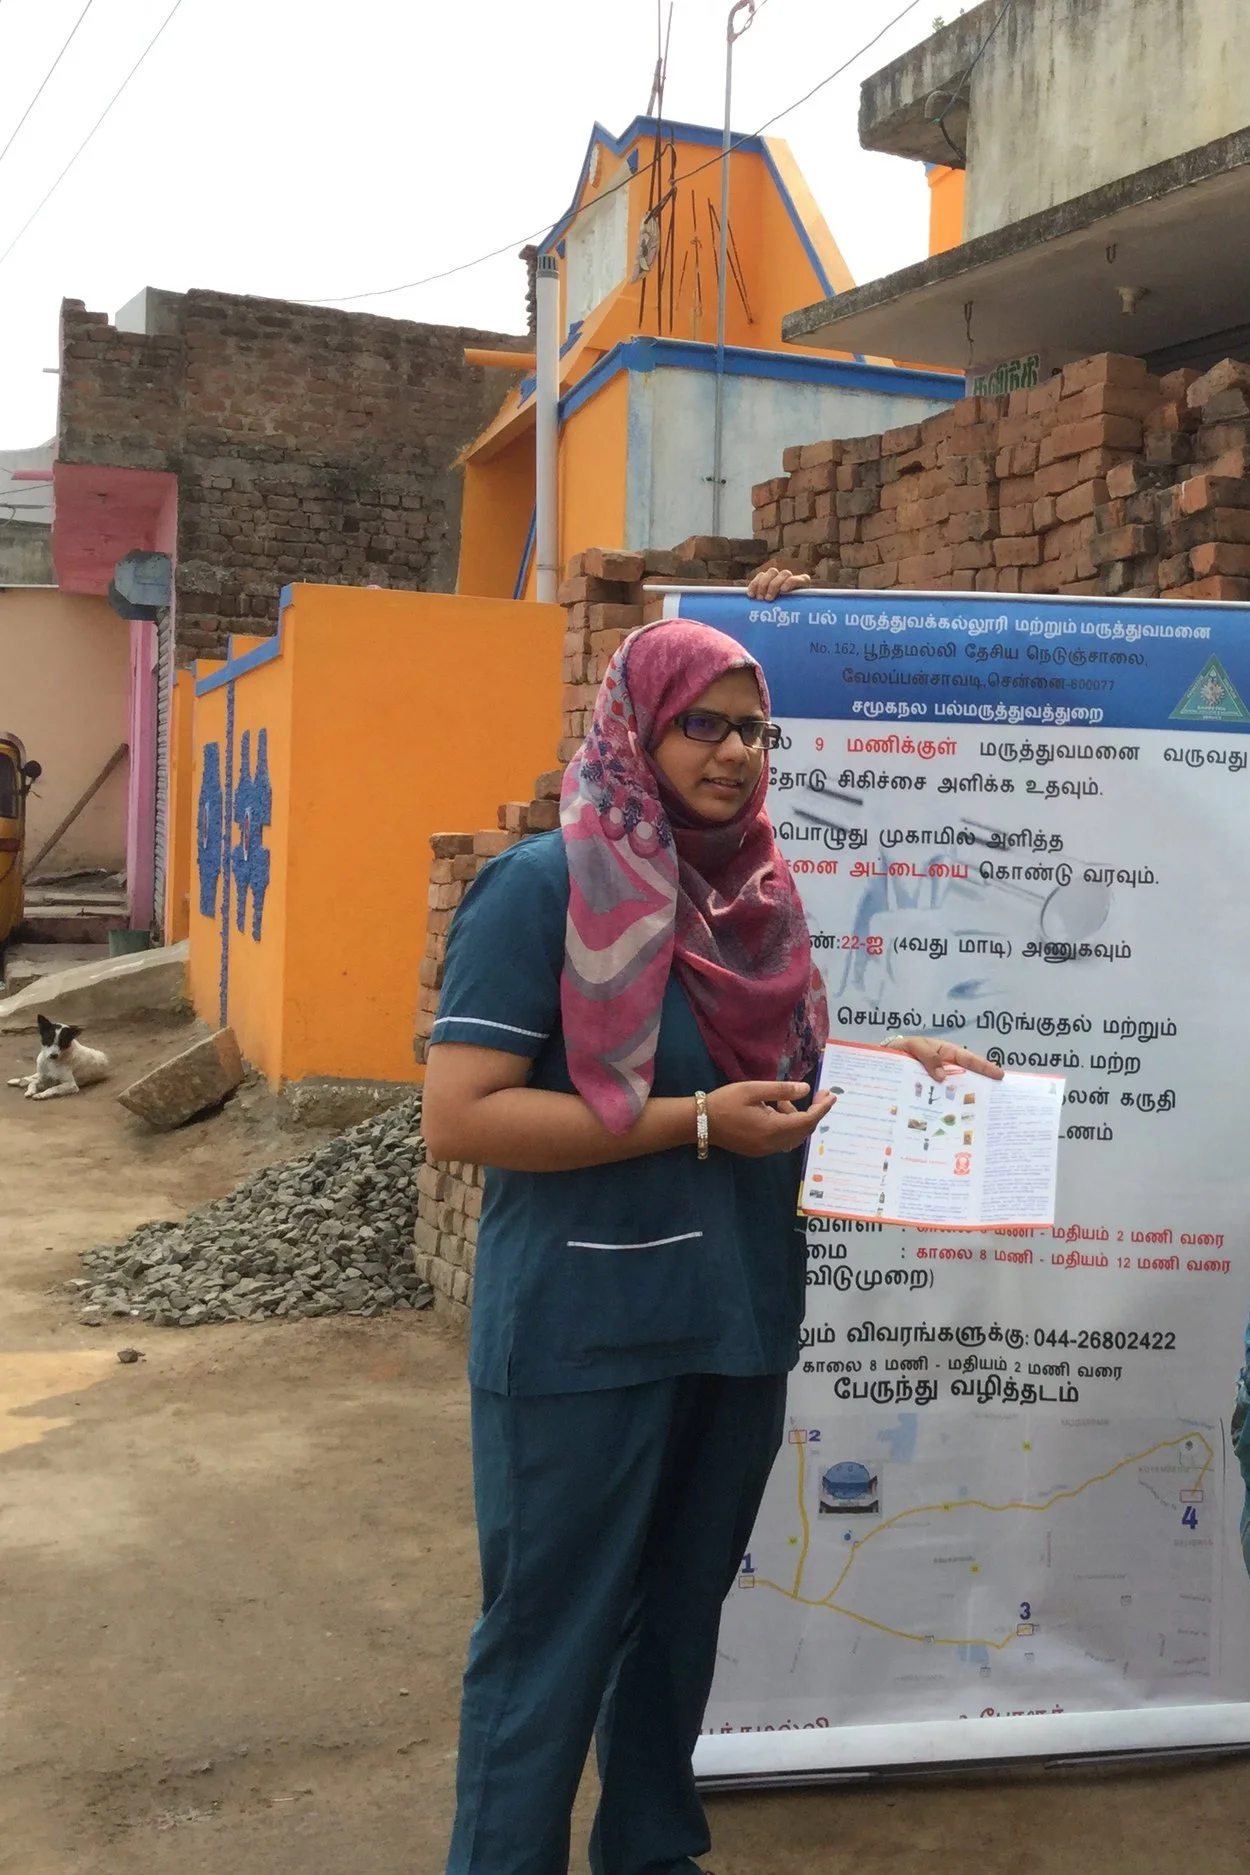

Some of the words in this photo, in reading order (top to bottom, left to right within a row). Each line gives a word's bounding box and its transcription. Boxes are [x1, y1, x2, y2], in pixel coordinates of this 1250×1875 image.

[749, 607, 801, 627] சவீதா
[808, 611, 837, 626] பல்
[845, 611, 1008, 635] மருத்துவக்கல்லூரி
[1015, 616, 1077, 638] மற்றும்
[1081, 620, 1212, 642] மருத்துவமனை
[810, 642, 830, 655] No.
[835, 643, 860, 656] 162,
[864, 640, 956, 662] பூந்தமல்லி
[964, 643, 1018, 662] தேசிய
[852, 699, 927, 719] சமூகநல
[935, 701, 1104, 725] பல்மருத்துவத்துறை
[815, 737, 825, 751] 9
[847, 734, 957, 760] மணிக்குள்
[980, 739, 1140, 765] மருத்துவமனை
[1164, 747, 1248, 772] வருவது
[838, 769, 927, 791] சிகிச்சை
[937, 772, 1015, 794] அளிக்க
[1025, 776, 1104, 800] உதவும்.
[879, 826, 976, 847] முகாமில்
[986, 828, 1064, 854] அளித்த
[849, 859, 969, 879] அட்டையை
[979, 860, 1074, 887] கொண்டு
[1083, 865, 1160, 888] வரவும்.
[1021, 939, 1132, 963] அணுகவும்
[932, 1011, 966, 1028] பல்
[976, 1009, 1092, 1036] பிடுங்குதல்
[1102, 1016, 1177, 1043] மற்றும்
[1090, 1050, 1141, 1076] மற்ற
[1120, 1087, 1177, 1112] கருதி
[1051, 1224, 1108, 1243] மதியம்
[1116, 1231, 1124, 1242] 2
[1131, 1229, 1172, 1244] மணி
[1180, 1233, 1224, 1248] வரை
[916, 1248, 973, 1260] காலை
[979, 1249, 987, 1260] 8
[994, 1245, 1033, 1263] மணி
[1051, 1251, 1109, 1269] மதியம்
[1117, 1257, 1130, 1269] 12
[1137, 1255, 1179, 1271] மணி
[1186, 1259, 1231, 1275] வரை
[847, 1321, 1029, 1348] விவரங்களுக்கு:
[1034, 1328, 1176, 1350] 044-26802422
[803, 1360, 862, 1374] காலை
[869, 1360, 877, 1372] 8
[885, 1355, 928, 1371] மணி
[948, 1354, 1007, 1374] மதியம்
[1014, 1361, 1021, 1372] 2
[1028, 1361, 1070, 1377] மணி
[1077, 1366, 1122, 1382] வரை
[834, 1374, 938, 1406] பேருந்து
[950, 1373, 1079, 1405] வழித்தடம்
[808, 1429, 821, 1442] 2
[1181, 1505, 1198, 1529] 4
[741, 1553, 755, 1573] 1
[1019, 1601, 1032, 1620] 3
